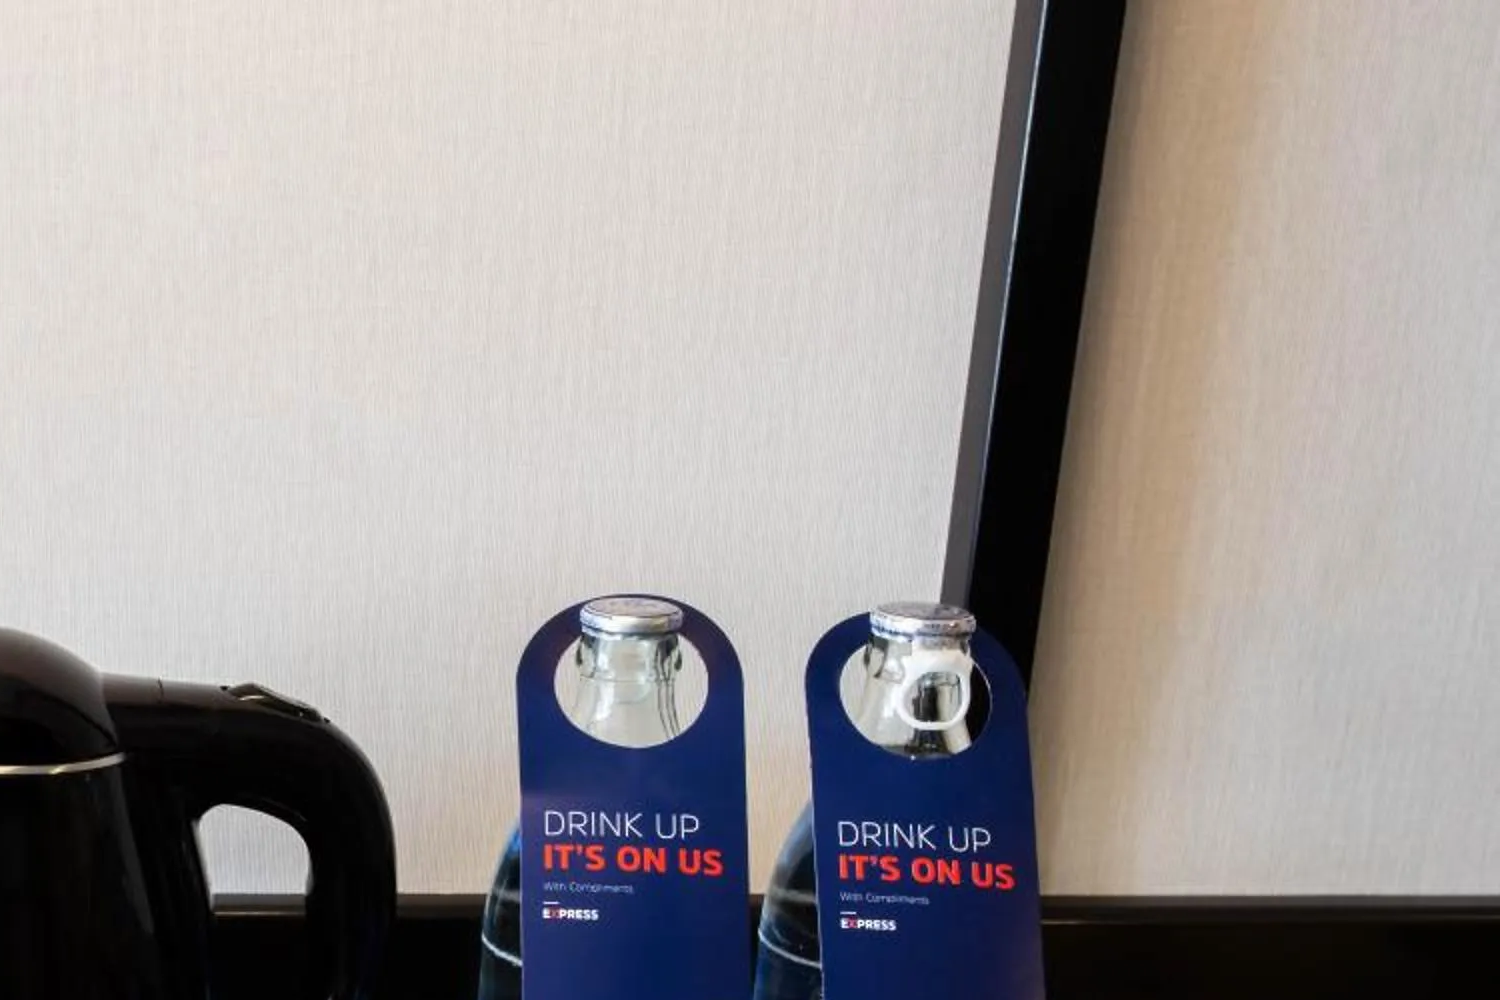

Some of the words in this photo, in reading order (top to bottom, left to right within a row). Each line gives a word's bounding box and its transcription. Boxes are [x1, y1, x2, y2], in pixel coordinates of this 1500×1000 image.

[543, 810, 643, 838] DRINK
[655, 813, 700, 839] UP
[837, 821, 937, 851] DRINK
[948, 826, 992, 853] UP
[542, 844, 607, 871] IT'S
[616, 847, 667, 873] ON
[678, 849, 724, 876] US
[838, 854, 900, 882] IT'S
[911, 857, 961, 886] ON
[971, 862, 1017, 890] US
[542, 907, 599, 921] EXPRESS
[841, 917, 897, 931] EXPRESS
